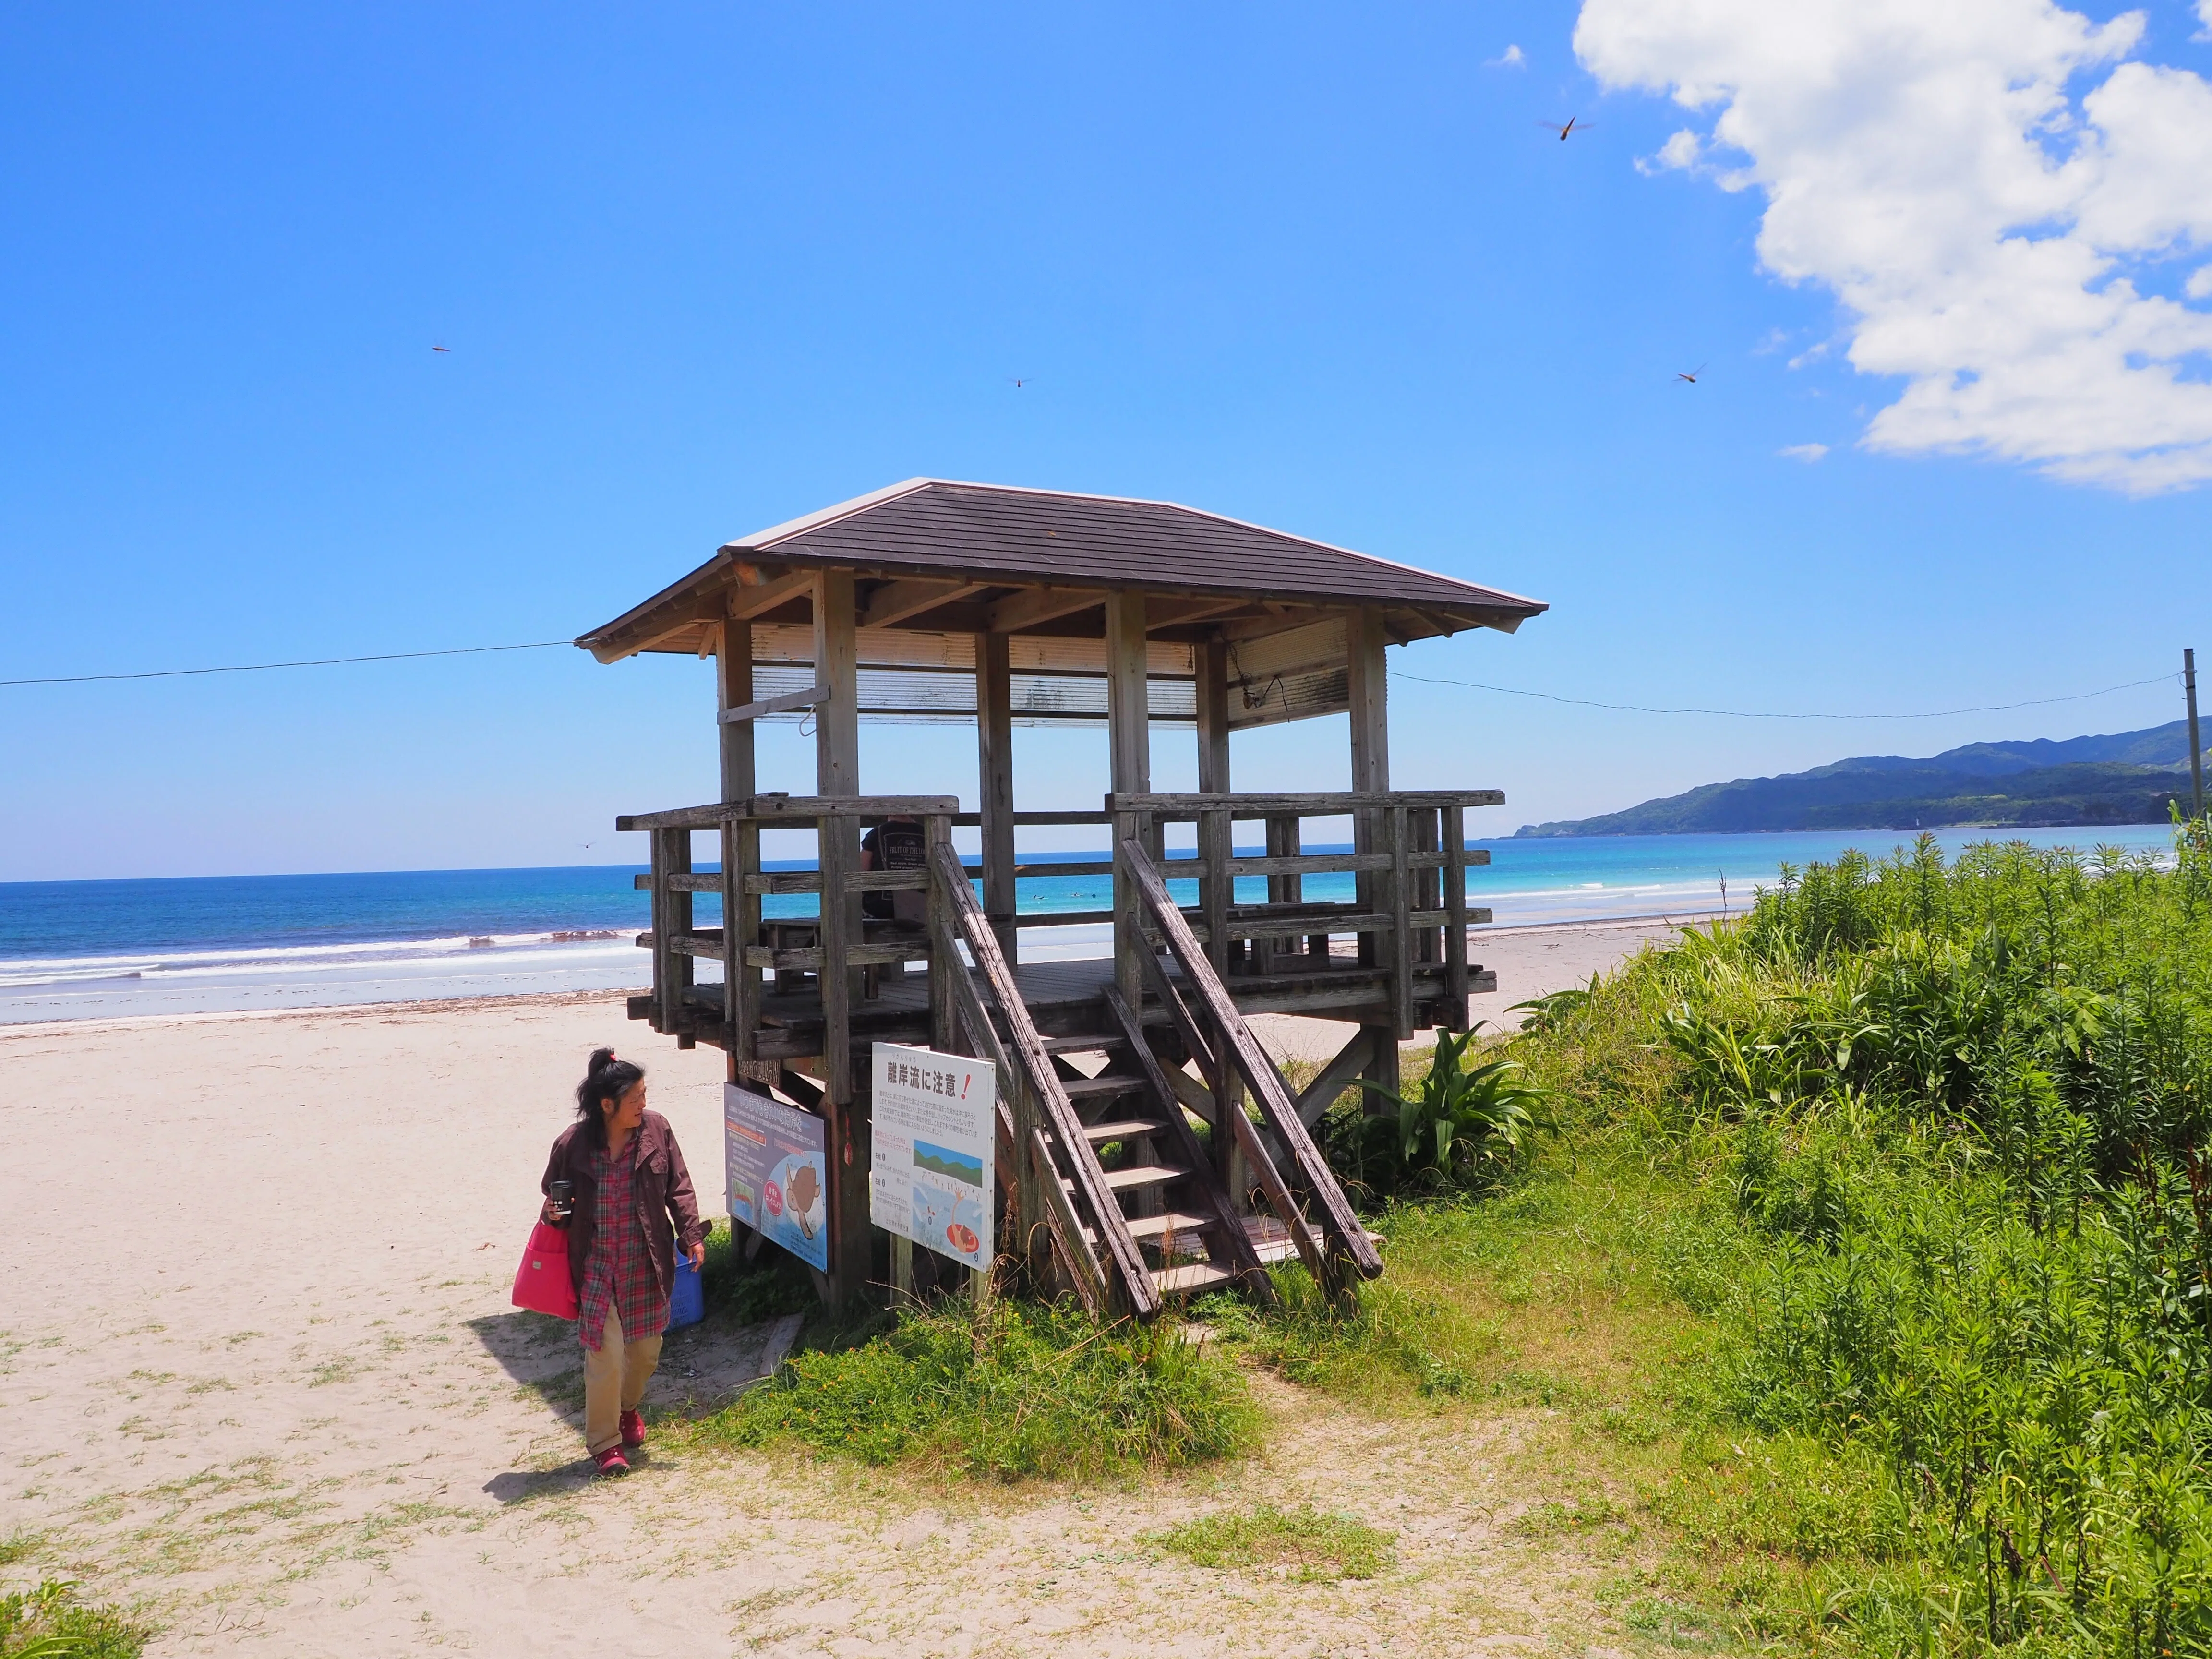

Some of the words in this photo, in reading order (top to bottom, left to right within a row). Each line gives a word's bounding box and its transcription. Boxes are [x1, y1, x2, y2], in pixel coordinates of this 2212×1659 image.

[892, 1053, 916, 1063] りがんりゅう
[887, 1061, 971, 1100] 離岸流に注意!
